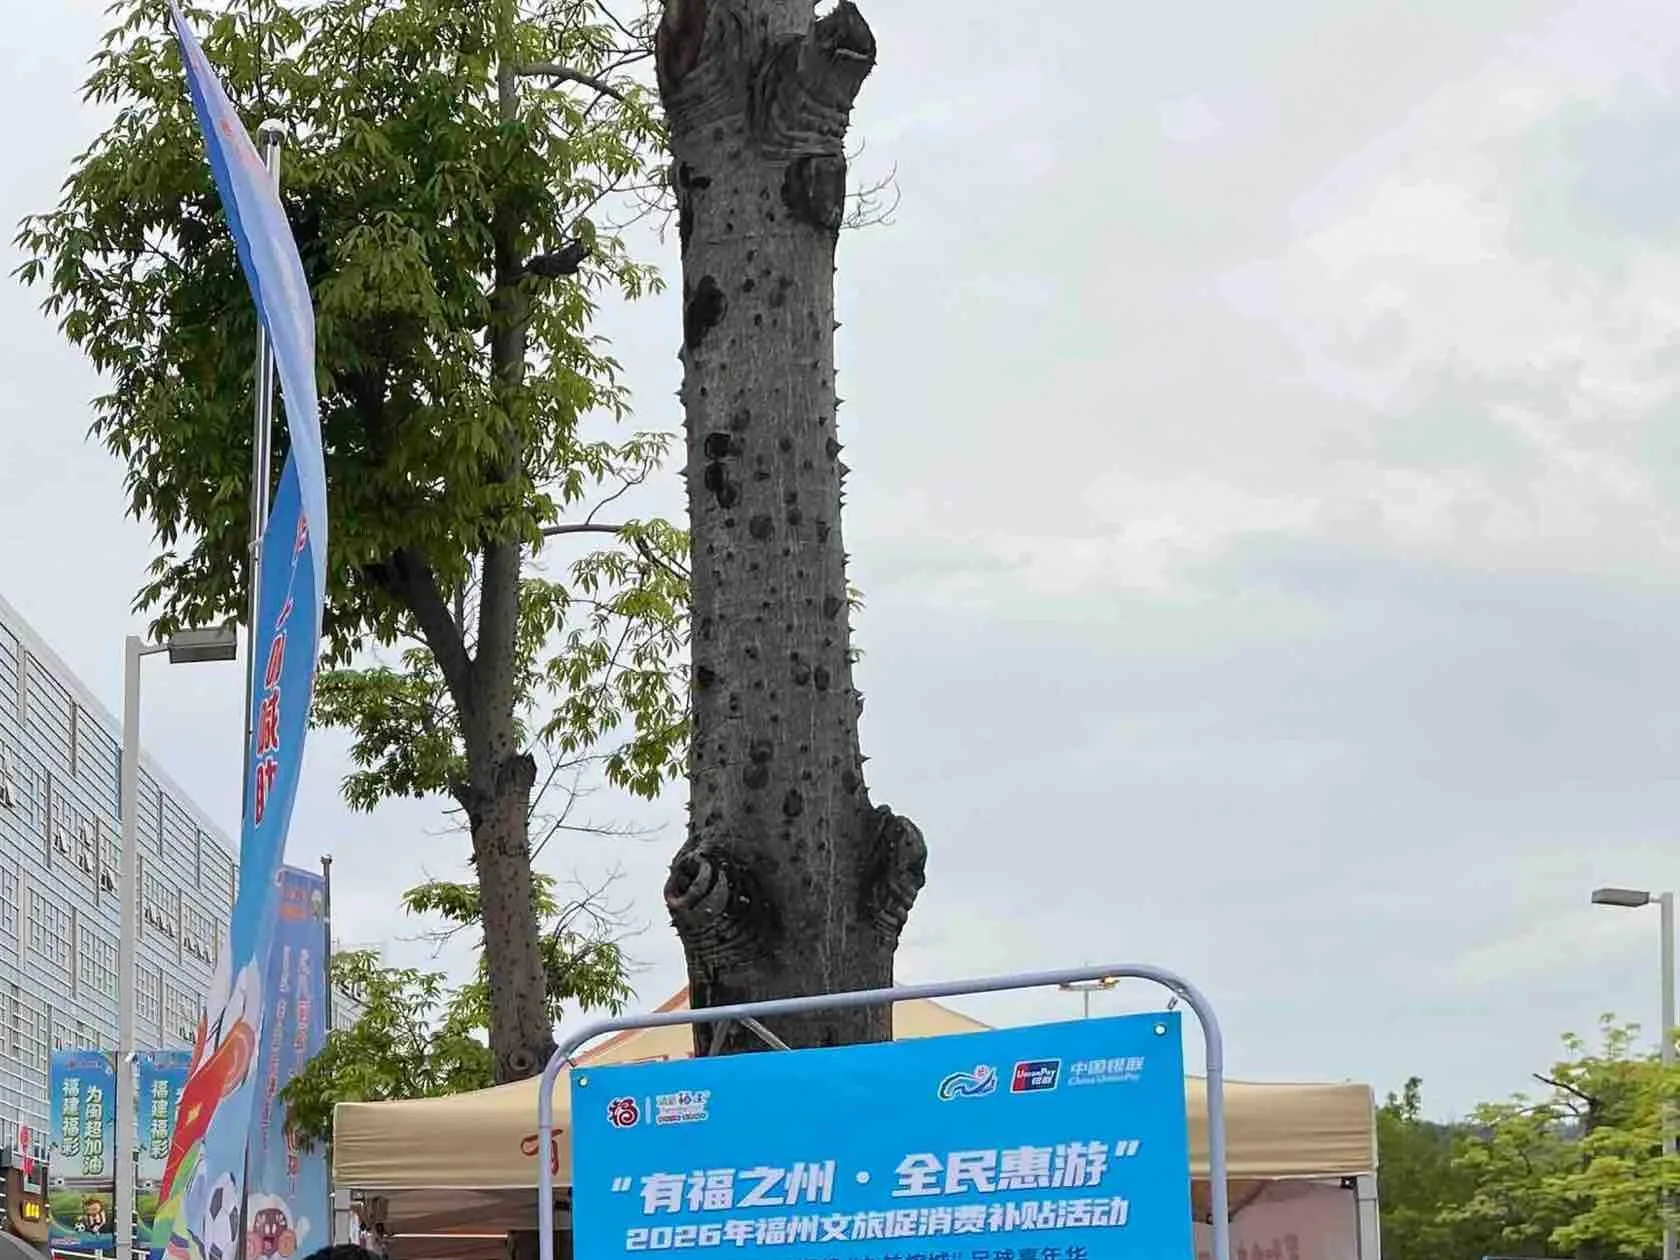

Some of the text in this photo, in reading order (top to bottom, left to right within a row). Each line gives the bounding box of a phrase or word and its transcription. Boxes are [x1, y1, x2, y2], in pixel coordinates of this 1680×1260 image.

[1070, 1056, 1145, 1076] 中国银联
[60, 1078, 80, 1158] 福建福彩
[82, 1085, 104, 1176] 为闽超加油
[150, 1080, 170, 1160] 福建福彩
[625, 1196, 1130, 1251] 2026年福州文旅促消费补贴活动
